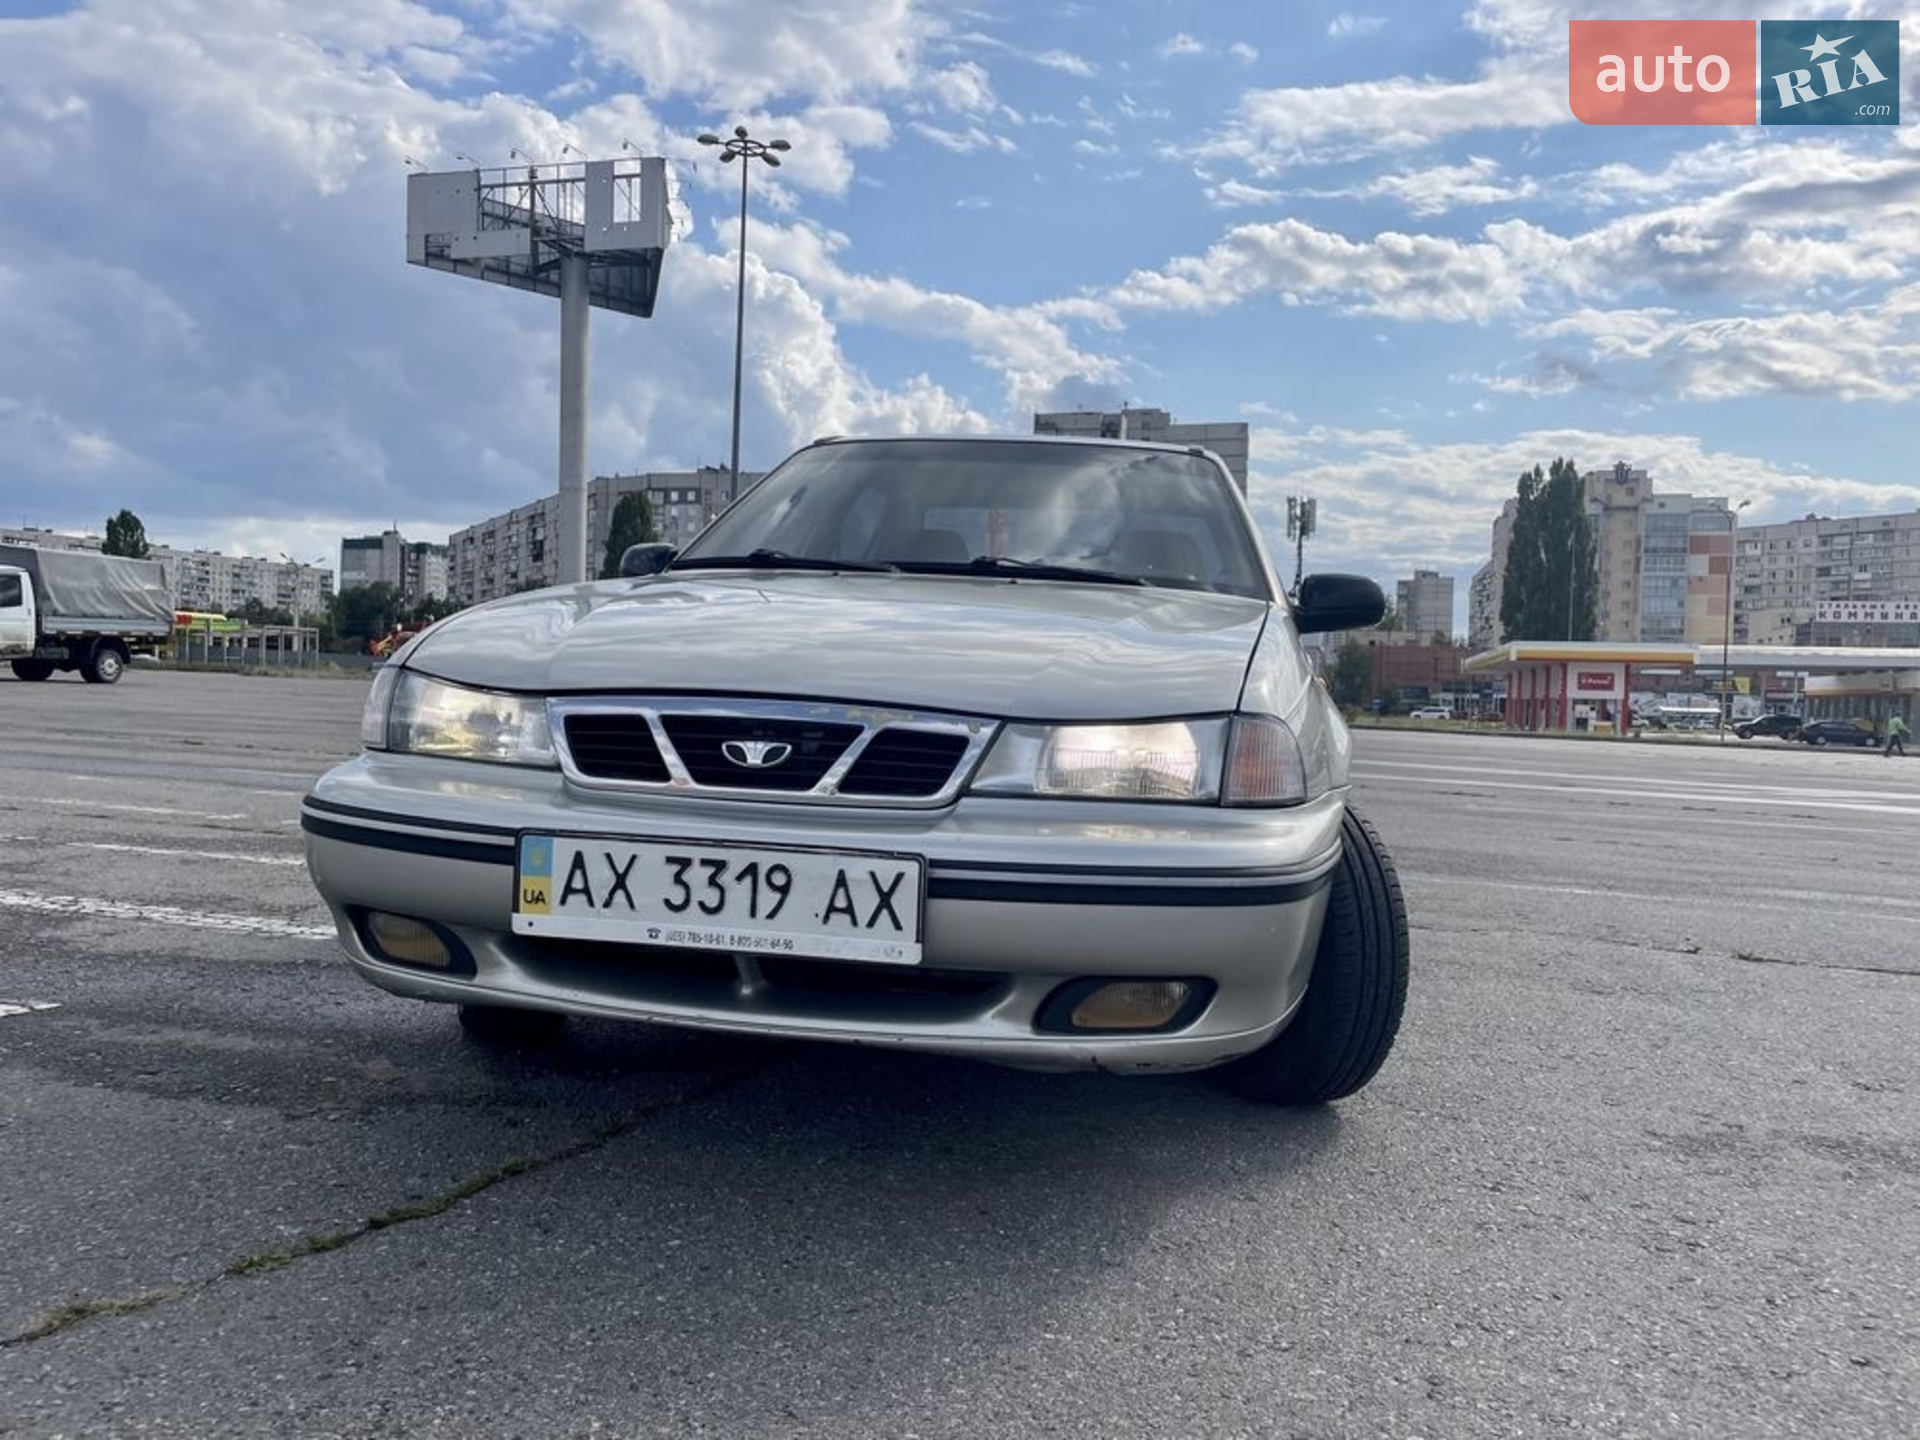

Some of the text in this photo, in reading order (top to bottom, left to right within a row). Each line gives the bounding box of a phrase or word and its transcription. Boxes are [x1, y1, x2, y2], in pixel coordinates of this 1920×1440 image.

[523, 888, 547, 905] UA
[559, 849, 906, 932] AX 3319 AX
